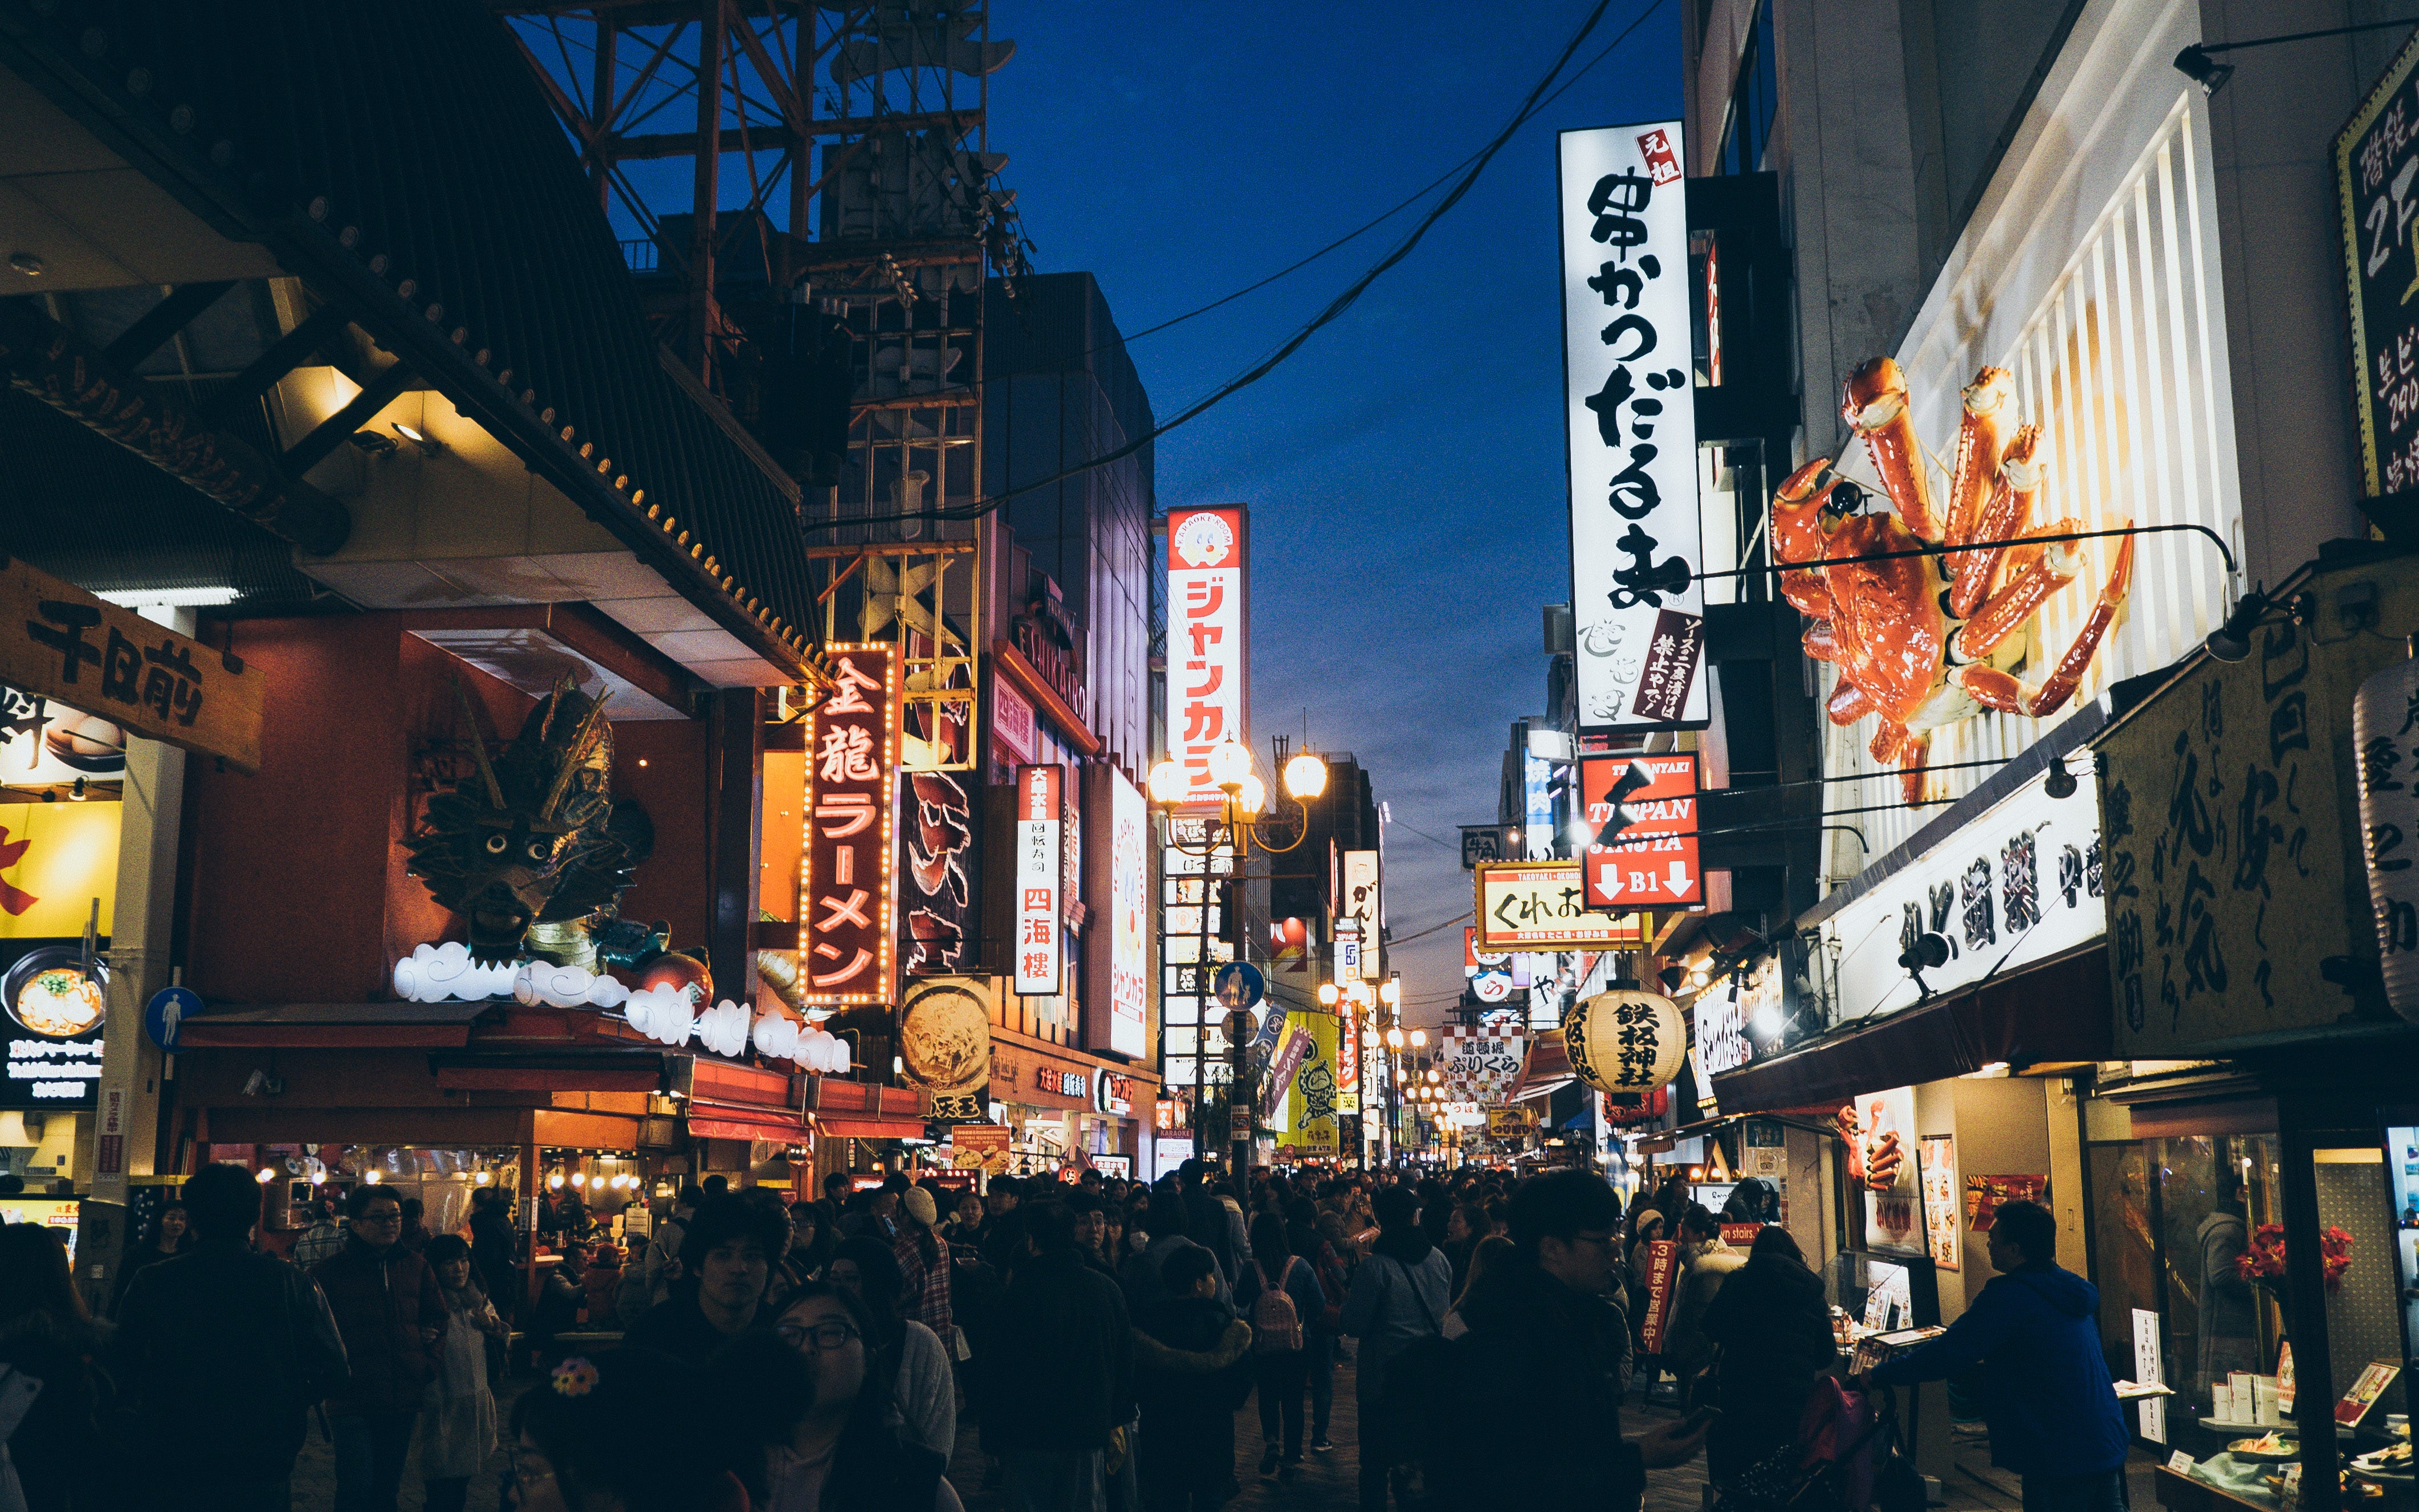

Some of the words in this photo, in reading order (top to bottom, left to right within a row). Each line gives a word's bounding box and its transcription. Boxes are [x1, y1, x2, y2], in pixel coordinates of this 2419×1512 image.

[1645, 133, 1680, 184] 元祖
[1585, 165, 1686, 610] 串かつだるま
[26, 600, 204, 727] 千日前
[1184, 577, 1223, 786] ジャンカラ
[1661, 618, 1703, 720] ソースの二度漬けは
[1031, 768, 1048, 820] 大水
[1526, 759, 1552, 814] 焼肉
[1589, 799, 1692, 823] TEPAN
[812, 656, 881, 987] 金龍ラーメン
[1032, 822, 1045, 873] 回転寿司
[1628, 870, 1660, 893] B1
[1024, 888, 1051, 979] 四海樓
[1447, 1055, 1520, 1075] ぷりくら
[1461, 1041, 1505, 1055] 道頓堀
[1612, 1002, 1660, 1087] 鉄板神社
